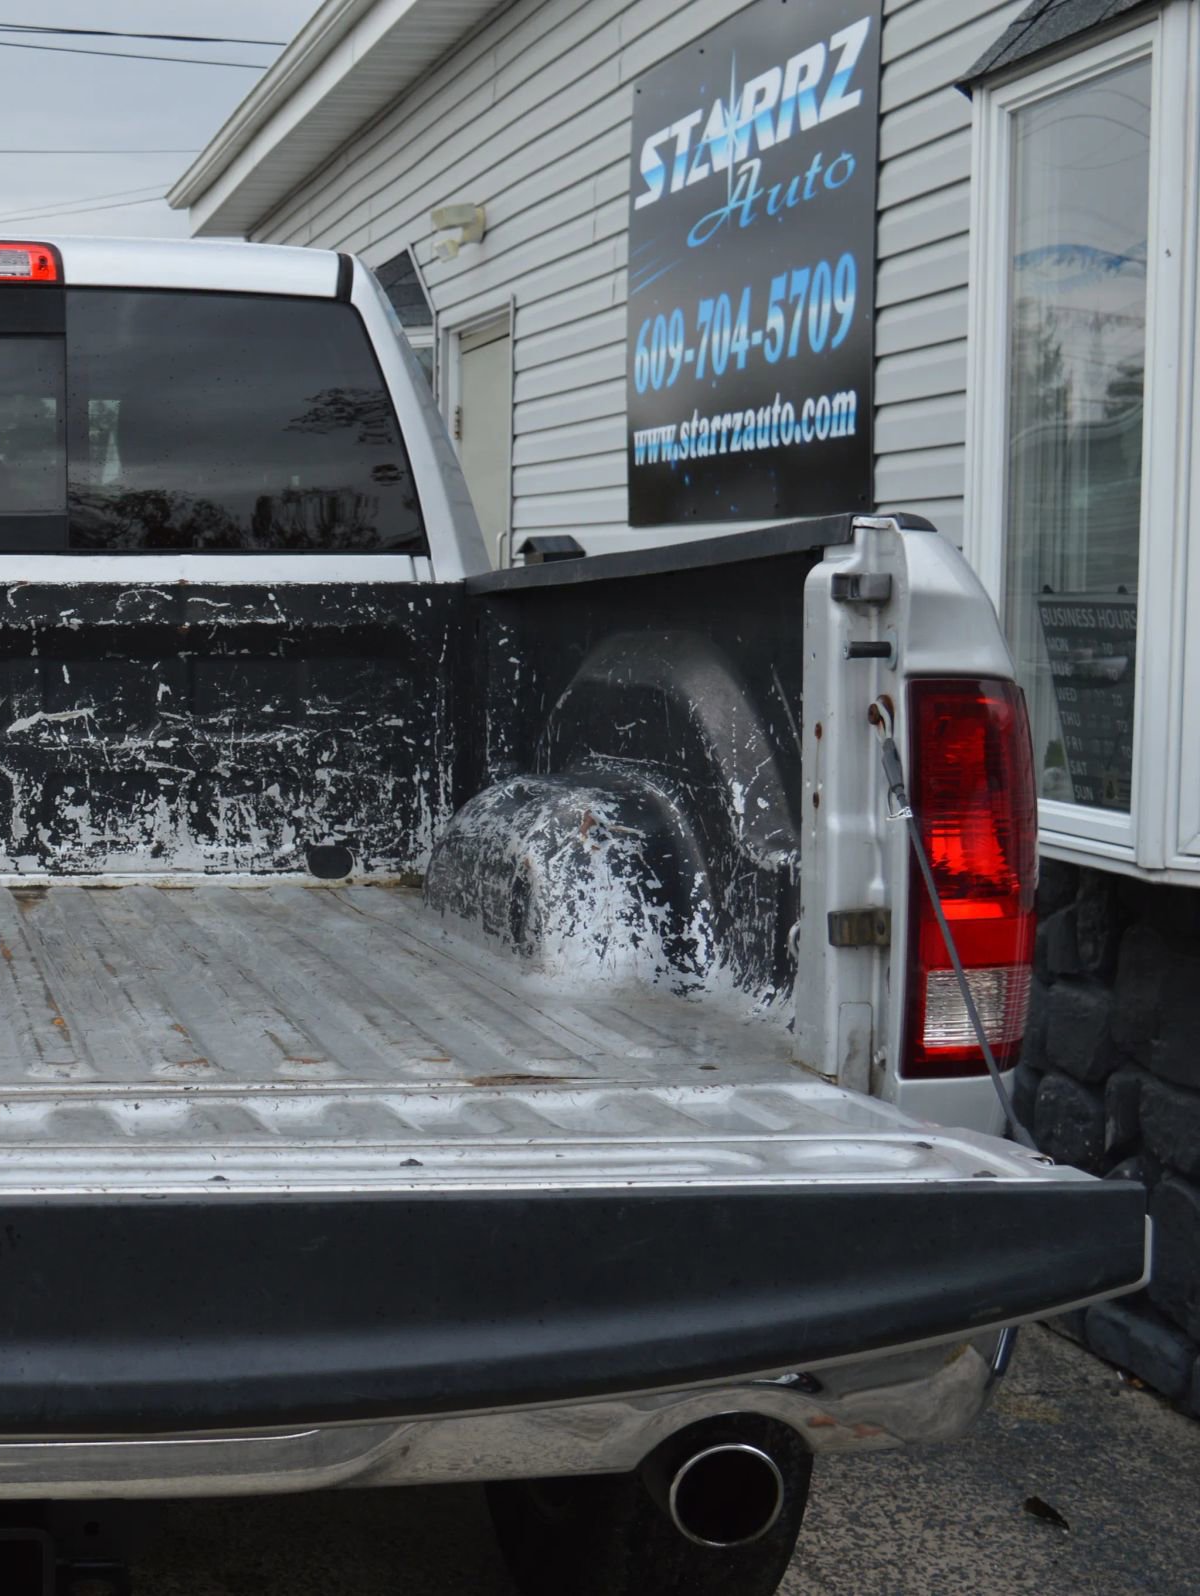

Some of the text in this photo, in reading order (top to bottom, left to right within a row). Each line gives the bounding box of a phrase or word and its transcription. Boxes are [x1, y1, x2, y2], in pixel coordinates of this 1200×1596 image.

[634, 16, 871, 210] STARRZ
[687, 150, 857, 247] Auto
[634, 252, 857, 395] 609-704-5709
[633, 390, 857, 466] www.starrzauto.com
[1041, 607, 1137, 630] BUSINESS HOURS
[1057, 687, 1078, 702] WED
[1061, 711, 1081, 727] THU
[1066, 736, 1083, 751] FRI
[1070, 760, 1088, 776] SAT
[1074, 785, 1094, 801] SUN
